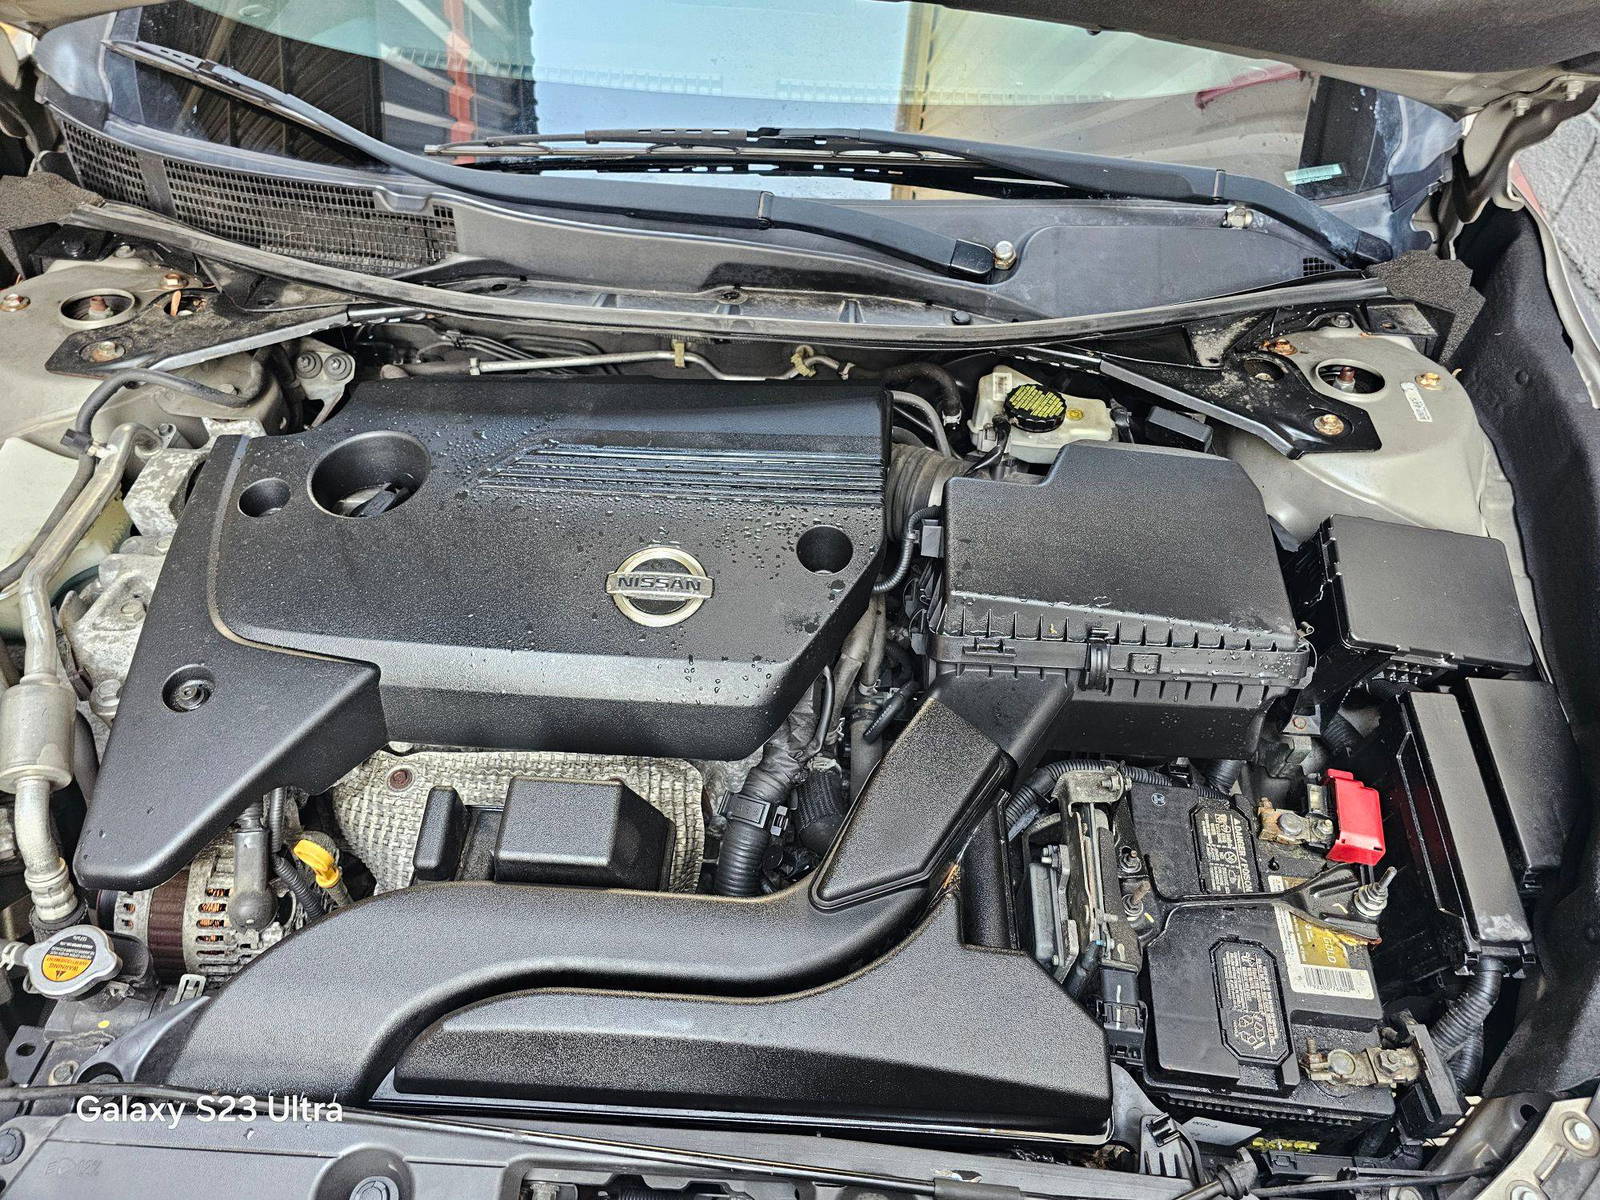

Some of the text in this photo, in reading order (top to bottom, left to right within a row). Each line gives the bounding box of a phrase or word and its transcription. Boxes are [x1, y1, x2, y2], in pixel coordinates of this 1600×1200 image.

[618, 577, 701, 591] NISSAN
[1234, 826, 1247, 857] DANGER
[1241, 863, 1254, 893] POISON
[1323, 938, 1337, 963] GOLD
[48, 963, 79, 972] WARNING
